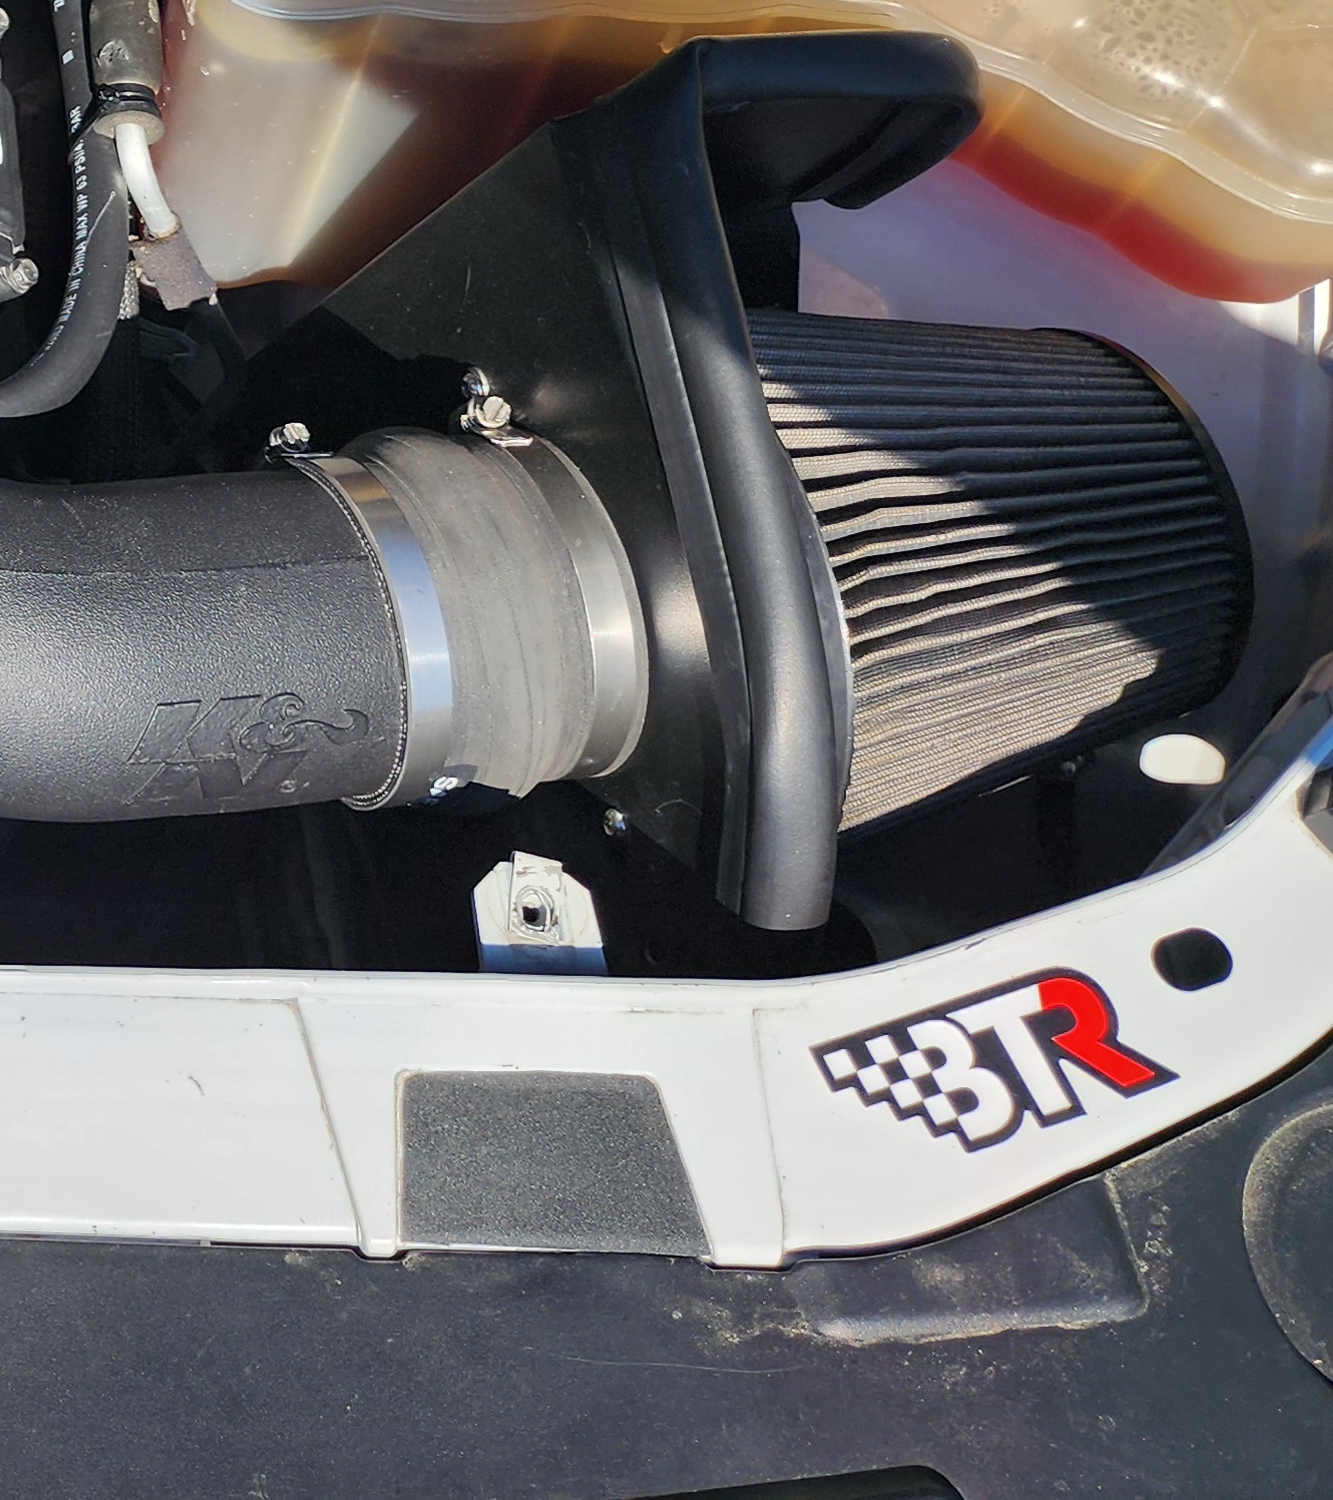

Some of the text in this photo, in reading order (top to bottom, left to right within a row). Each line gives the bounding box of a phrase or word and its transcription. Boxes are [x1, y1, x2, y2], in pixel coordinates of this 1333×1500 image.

[76, 174, 88, 189] 63
[76, 193, 88, 211] WP
[75, 213, 89, 239] MAX
[71, 239, 88, 276] CHINA
[67, 278, 81, 291] IN
[878, 969, 1166, 1148] BTR
